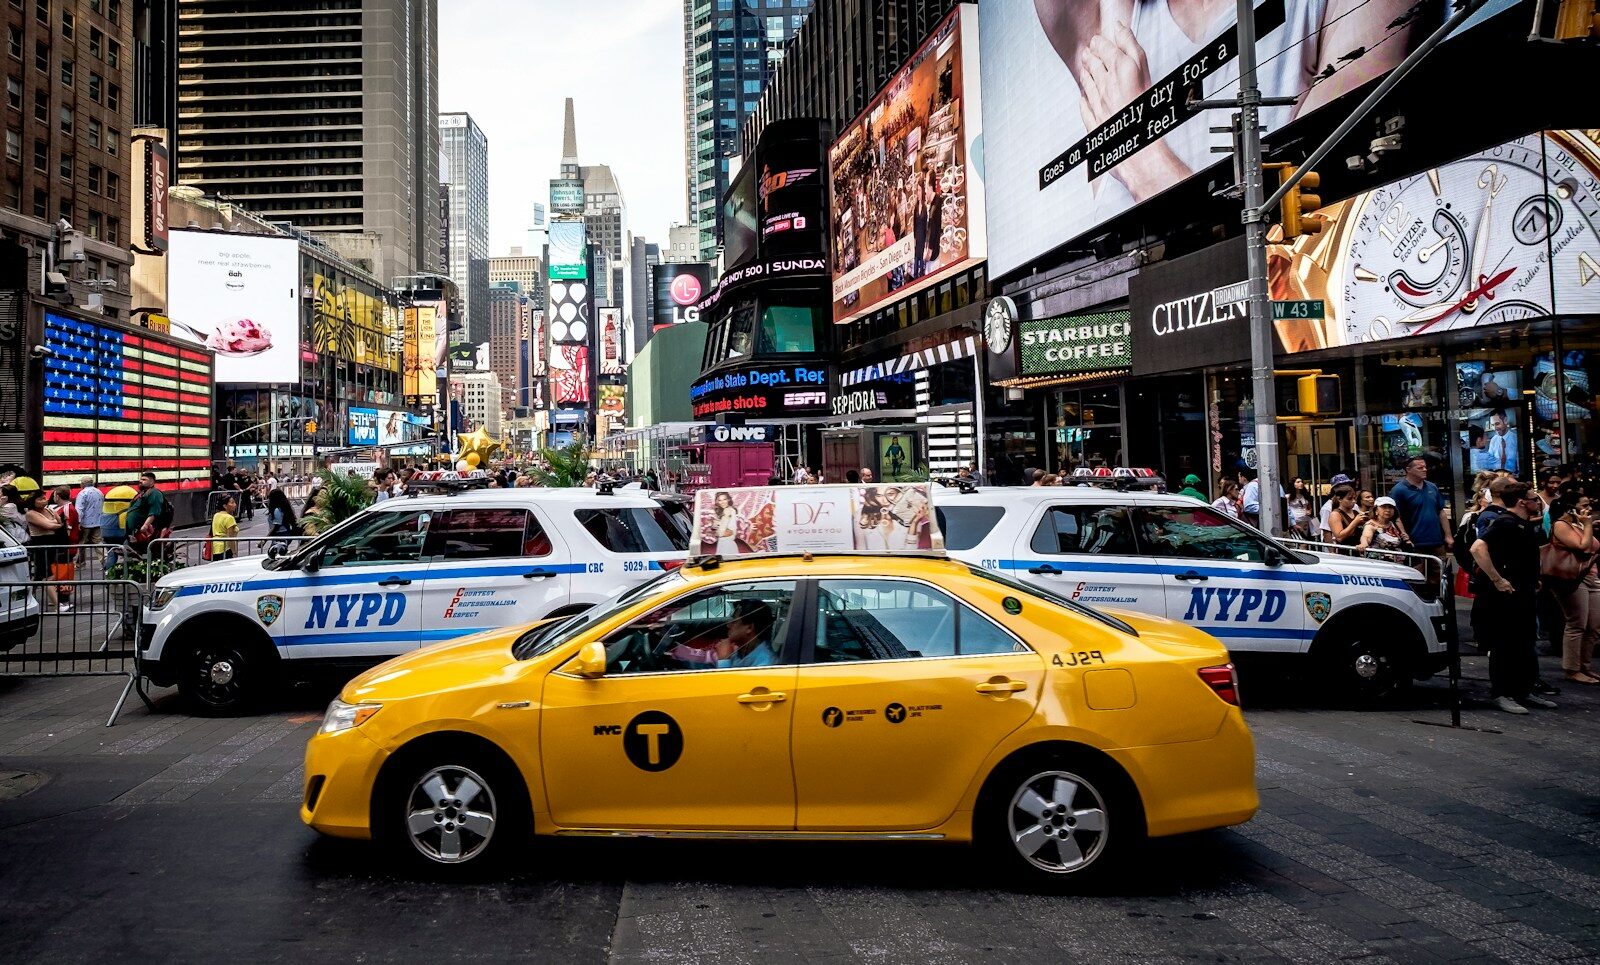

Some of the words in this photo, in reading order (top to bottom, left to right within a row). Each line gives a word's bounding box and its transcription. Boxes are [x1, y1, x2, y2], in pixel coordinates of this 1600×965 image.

[1043, 160, 1065, 182] Goes
[1068, 152, 1082, 165] on
[1085, 102, 1144, 154] instantly
[1150, 81, 1174, 108] dry
[1182, 55, 1209, 86] for
[1217, 43, 1228, 60] a
[1093, 134, 1140, 173] cleaner
[1146, 106, 1178, 139] feel
[1555, 150, 1576, 172] DEL
[1392, 217, 1424, 259] CITIZEN
[1401, 226, 1428, 263] Eco-Drive
[903, 241, 911, 255] CA
[1511, 264, 1541, 294] Radio
[1534, 219, 1586, 264] Controlled
[728, 269, 745, 284] INDY
[745, 265, 763, 277] 500
[1215, 283, 1249, 306] BROADWAY
[673, 306, 700, 324] LG
[1274, 304, 1285, 318] W
[1290, 301, 1309, 316] 43
[1313, 301, 1322, 311] ST
[521, 302, 529, 340] NOVOTEL
[1044, 341, 1125, 361] COFFEE
[725, 373, 747, 388] State
[750, 369, 791, 386] Dept.
[733, 395, 767, 409] shots
[784, 392, 827, 406] ESPN
[832, 389, 877, 415] SEPHORA
[730, 427, 766, 441] NYC
[588, 562, 604, 573] CRC
[623, 561, 643, 571] 5029
[981, 559, 997, 569] CRC
[203, 581, 243, 594] POLICE
[1343, 575, 1382, 587] POLICE
[304, 591, 408, 629] NYPD
[1184, 587, 1287, 622] NYPD
[1052, 650, 1106, 668] 4J29
[593, 725, 622, 737] NYC
[636, 723, 670, 765] T
